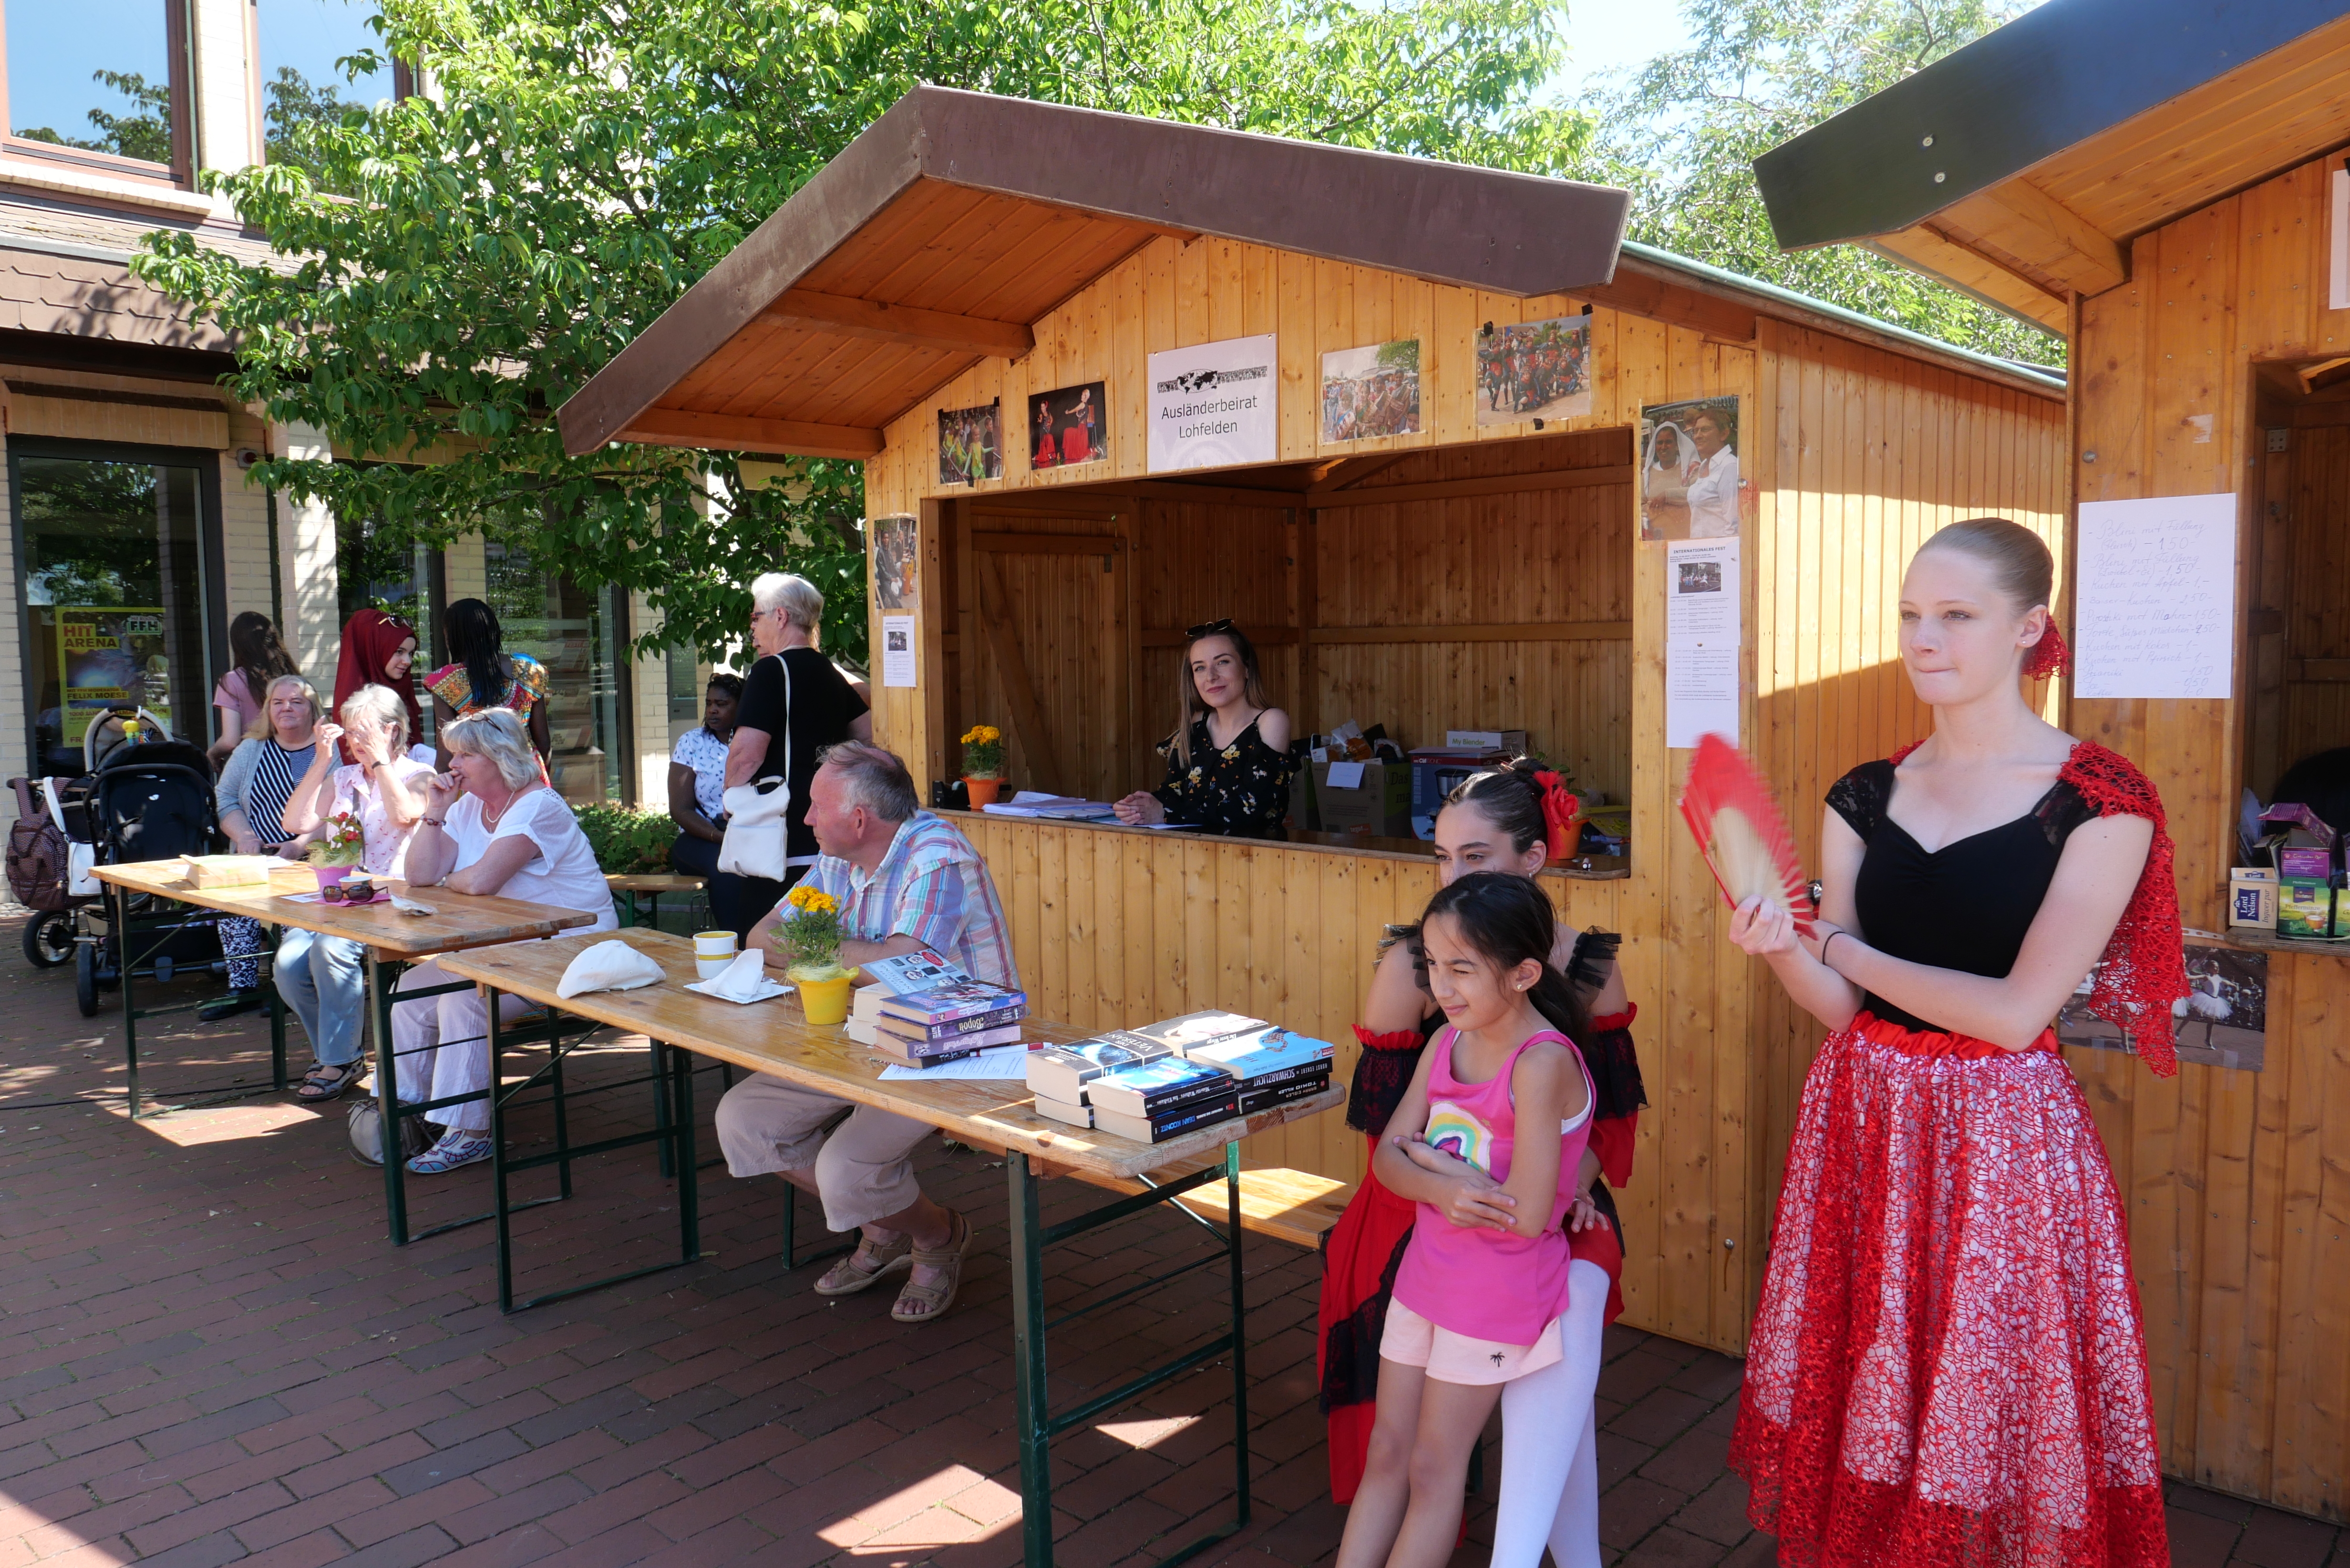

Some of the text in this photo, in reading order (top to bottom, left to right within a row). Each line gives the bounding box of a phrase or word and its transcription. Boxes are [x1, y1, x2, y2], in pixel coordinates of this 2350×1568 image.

[1161, 395, 1257, 420] Ausländerbeirat
[1179, 421, 1237, 438] Lohfelden
[2142, 520, 2164, 535] mit
[2166, 519, 2208, 538] Füllung
[2132, 551, 2153, 564] mit
[2091, 578, 2127, 590] Kuchen
[2132, 577, 2152, 587] mit
[2127, 608, 2149, 621] mit
[63, 625, 93, 637] HIT
[130, 621, 158, 631] FFH
[64, 638, 117, 647] ARENA
[2085, 640, 2120, 651] Kuchen
[2125, 640, 2142, 650] mit
[2084, 653, 2116, 664] Kuchen
[2123, 650, 2143, 662] mit
[1391, 772, 1408, 785] Das
[2240, 897, 2248, 913] Lord
[2247, 893, 2257, 917] Nelson
[2262, 902, 2270, 923] Ingwer
[959, 1017, 984, 1032] Ворон
[1107, 1034, 1153, 1052] VETERAN
[1253, 1063, 1328, 1087] HORST ECKERT SCHWARZLICHT
[1278, 1081, 1317, 1094] TOKIO KILLER
[1286, 1090, 1302, 1098] EISLER
[1180, 1091, 1196, 1099] Walters
[1160, 1120, 1181, 1133] KOONTZ
[1182, 1115, 1196, 1125] DEAN
